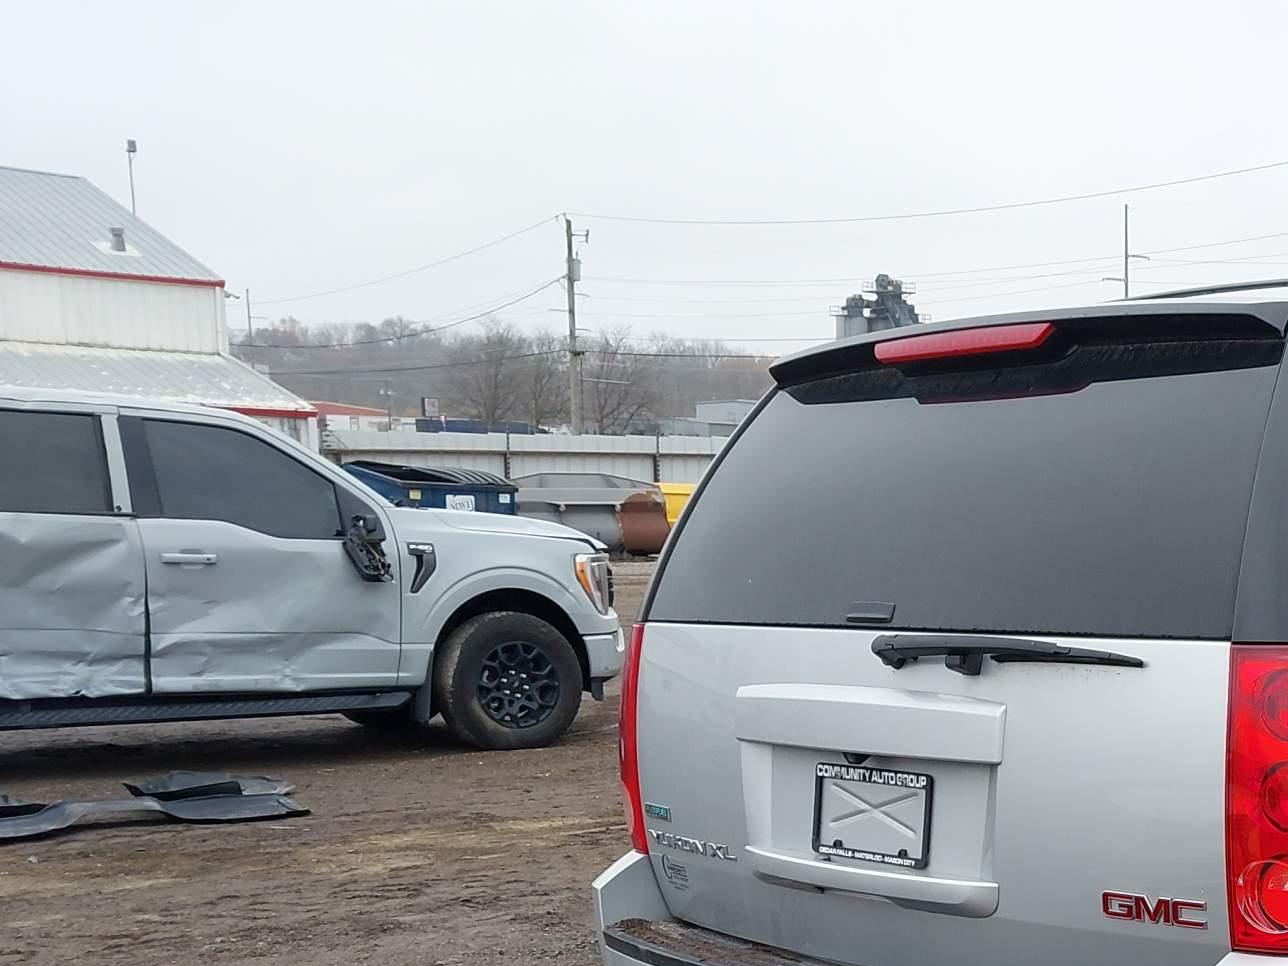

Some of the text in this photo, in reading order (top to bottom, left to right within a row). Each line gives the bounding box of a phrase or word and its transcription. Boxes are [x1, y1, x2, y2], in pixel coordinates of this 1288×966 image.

[817, 764, 927, 788] COMMUNITY AUTO GROUP
[708, 843, 738, 862] XL
[1102, 890, 1208, 929] GMC
